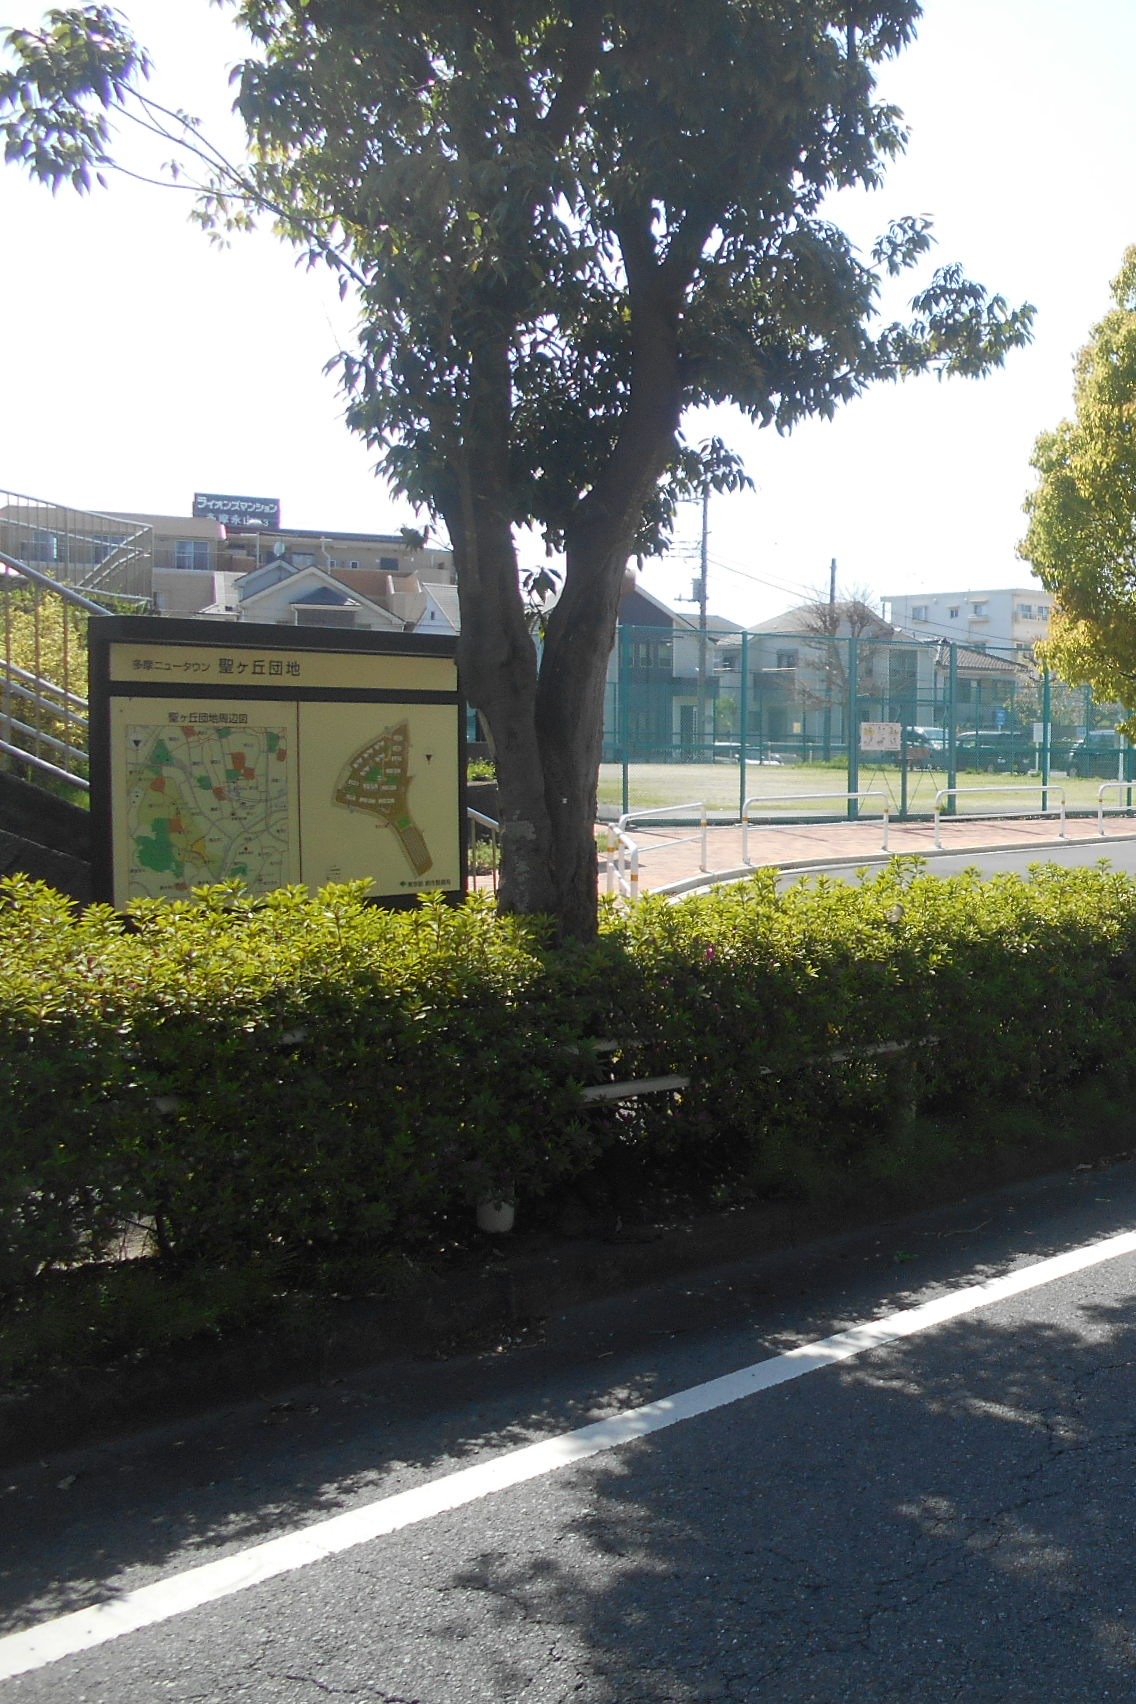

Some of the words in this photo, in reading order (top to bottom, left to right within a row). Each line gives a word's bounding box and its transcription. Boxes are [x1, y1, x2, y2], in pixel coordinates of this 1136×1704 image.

[197, 496, 278, 513] ライオンズマンション
[132, 659, 211, 673] 多摩ニュータウン
